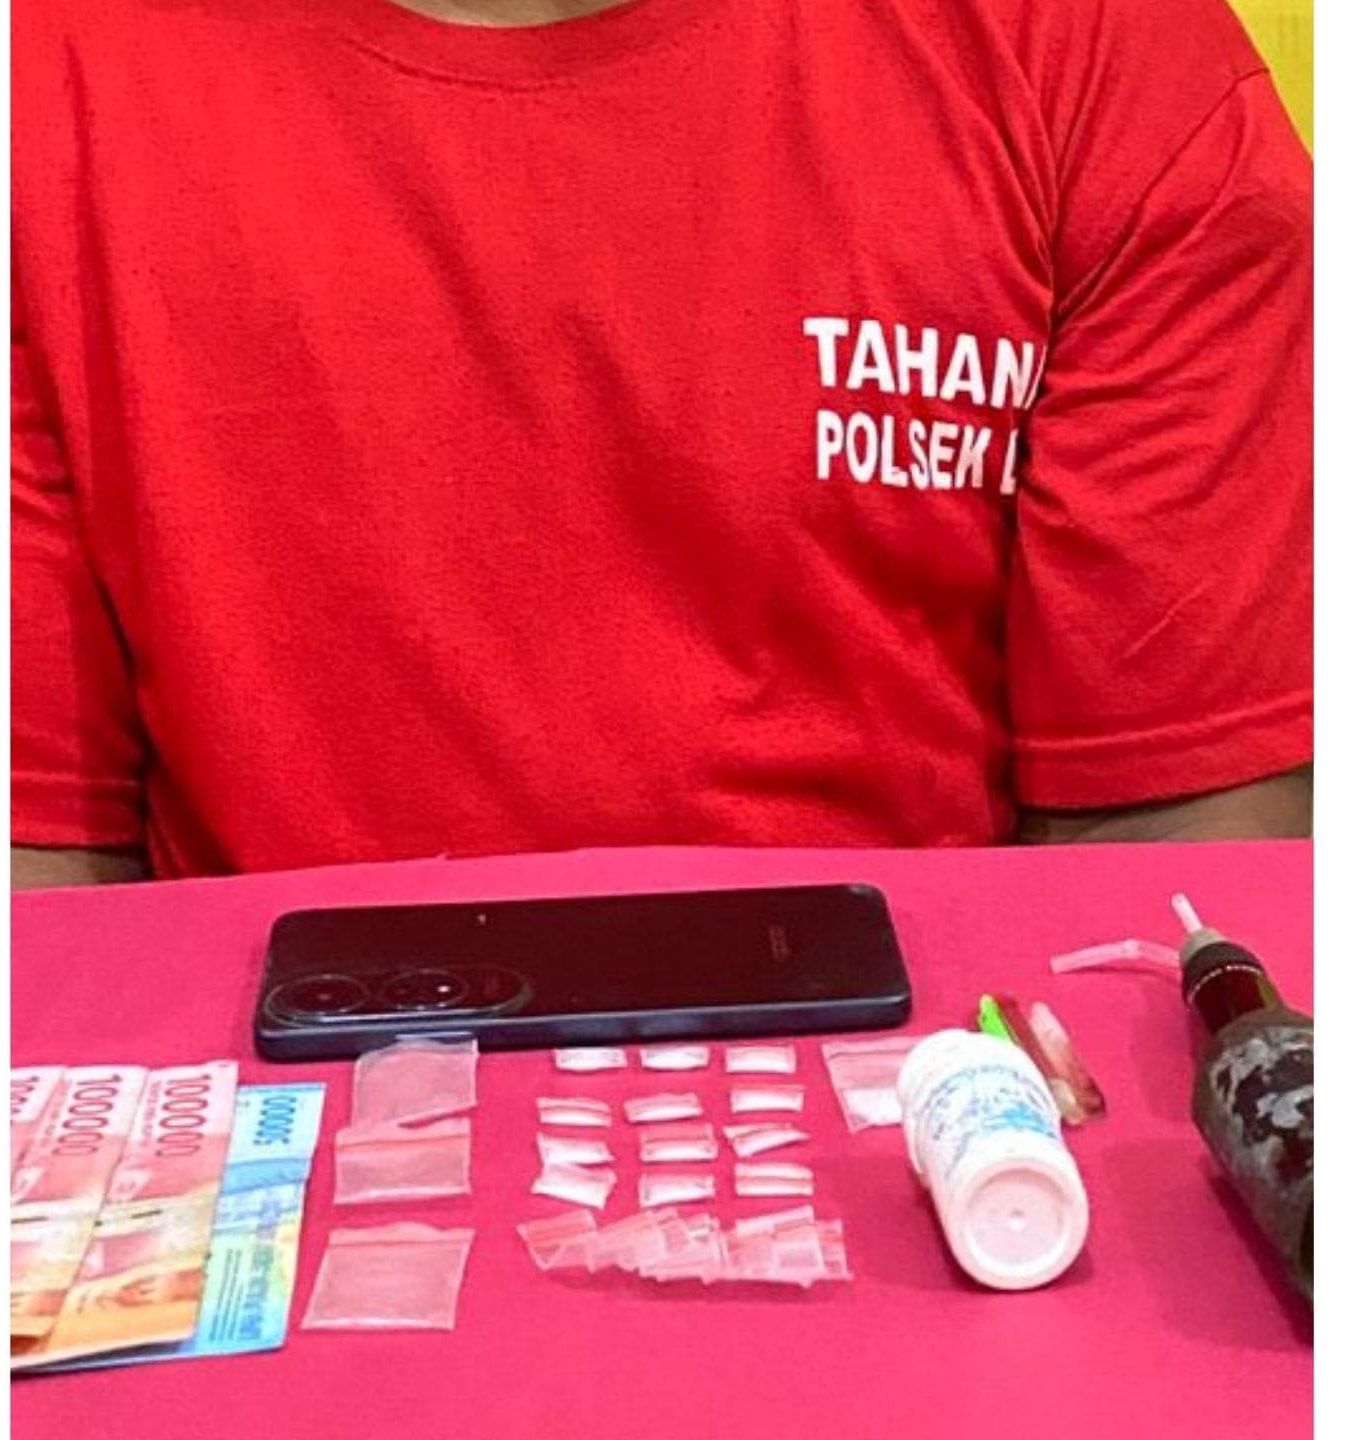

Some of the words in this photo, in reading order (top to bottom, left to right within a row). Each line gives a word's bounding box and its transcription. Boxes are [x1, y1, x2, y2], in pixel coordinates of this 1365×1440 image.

[817, 409, 992, 490] POLSEK
[52, 1074, 121, 1157] 100000
[155, 1074, 213, 1157] 100000
